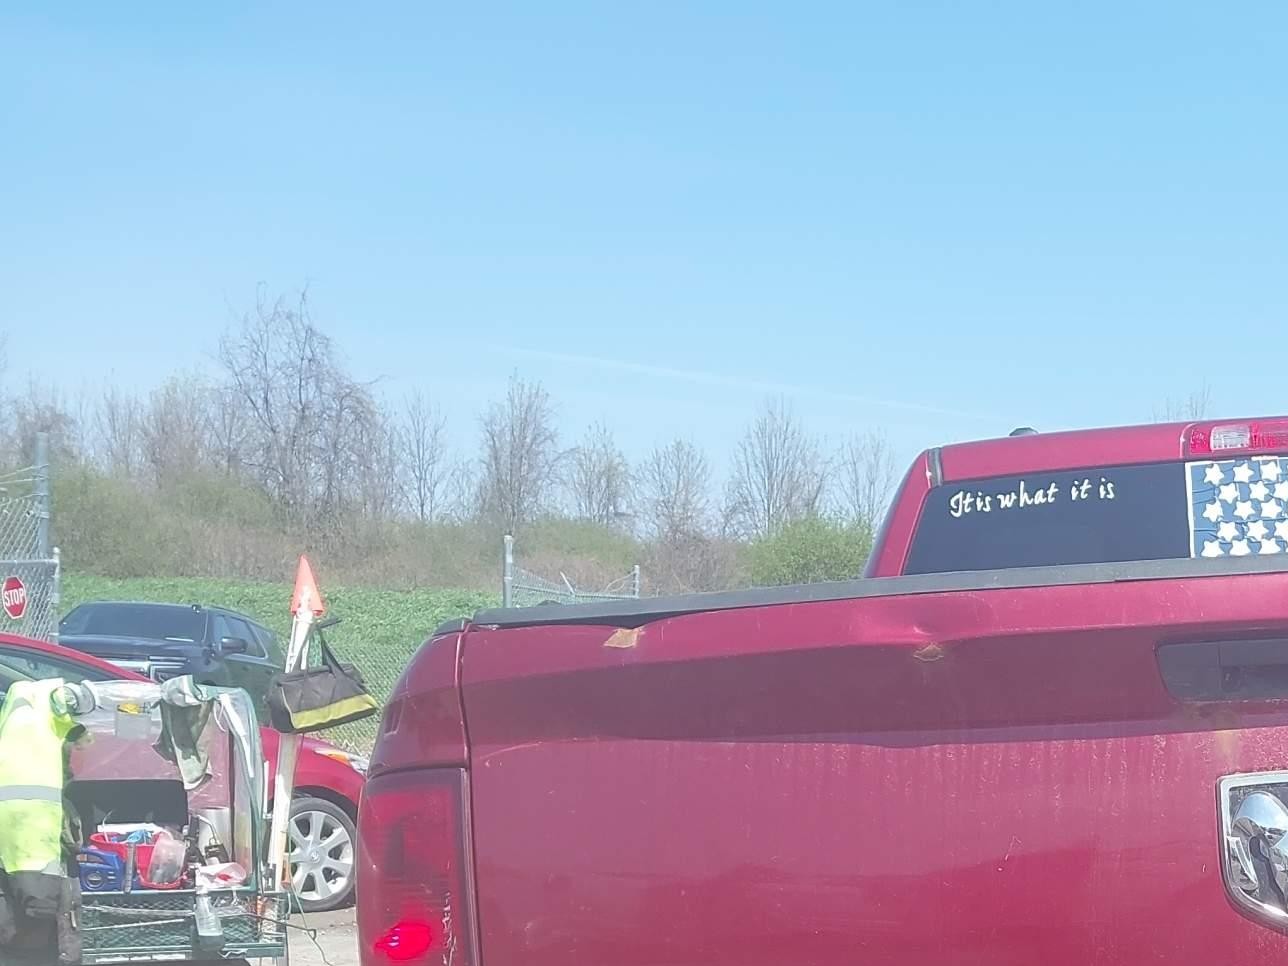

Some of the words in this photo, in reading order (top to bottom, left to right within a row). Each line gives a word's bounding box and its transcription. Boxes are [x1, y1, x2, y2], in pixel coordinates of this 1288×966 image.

[976, 491, 992, 512] is
[997, 480, 1060, 509] what
[1071, 478, 1092, 501] it
[1099, 477, 1115, 500] is
[4, 587, 24, 607] STOP
